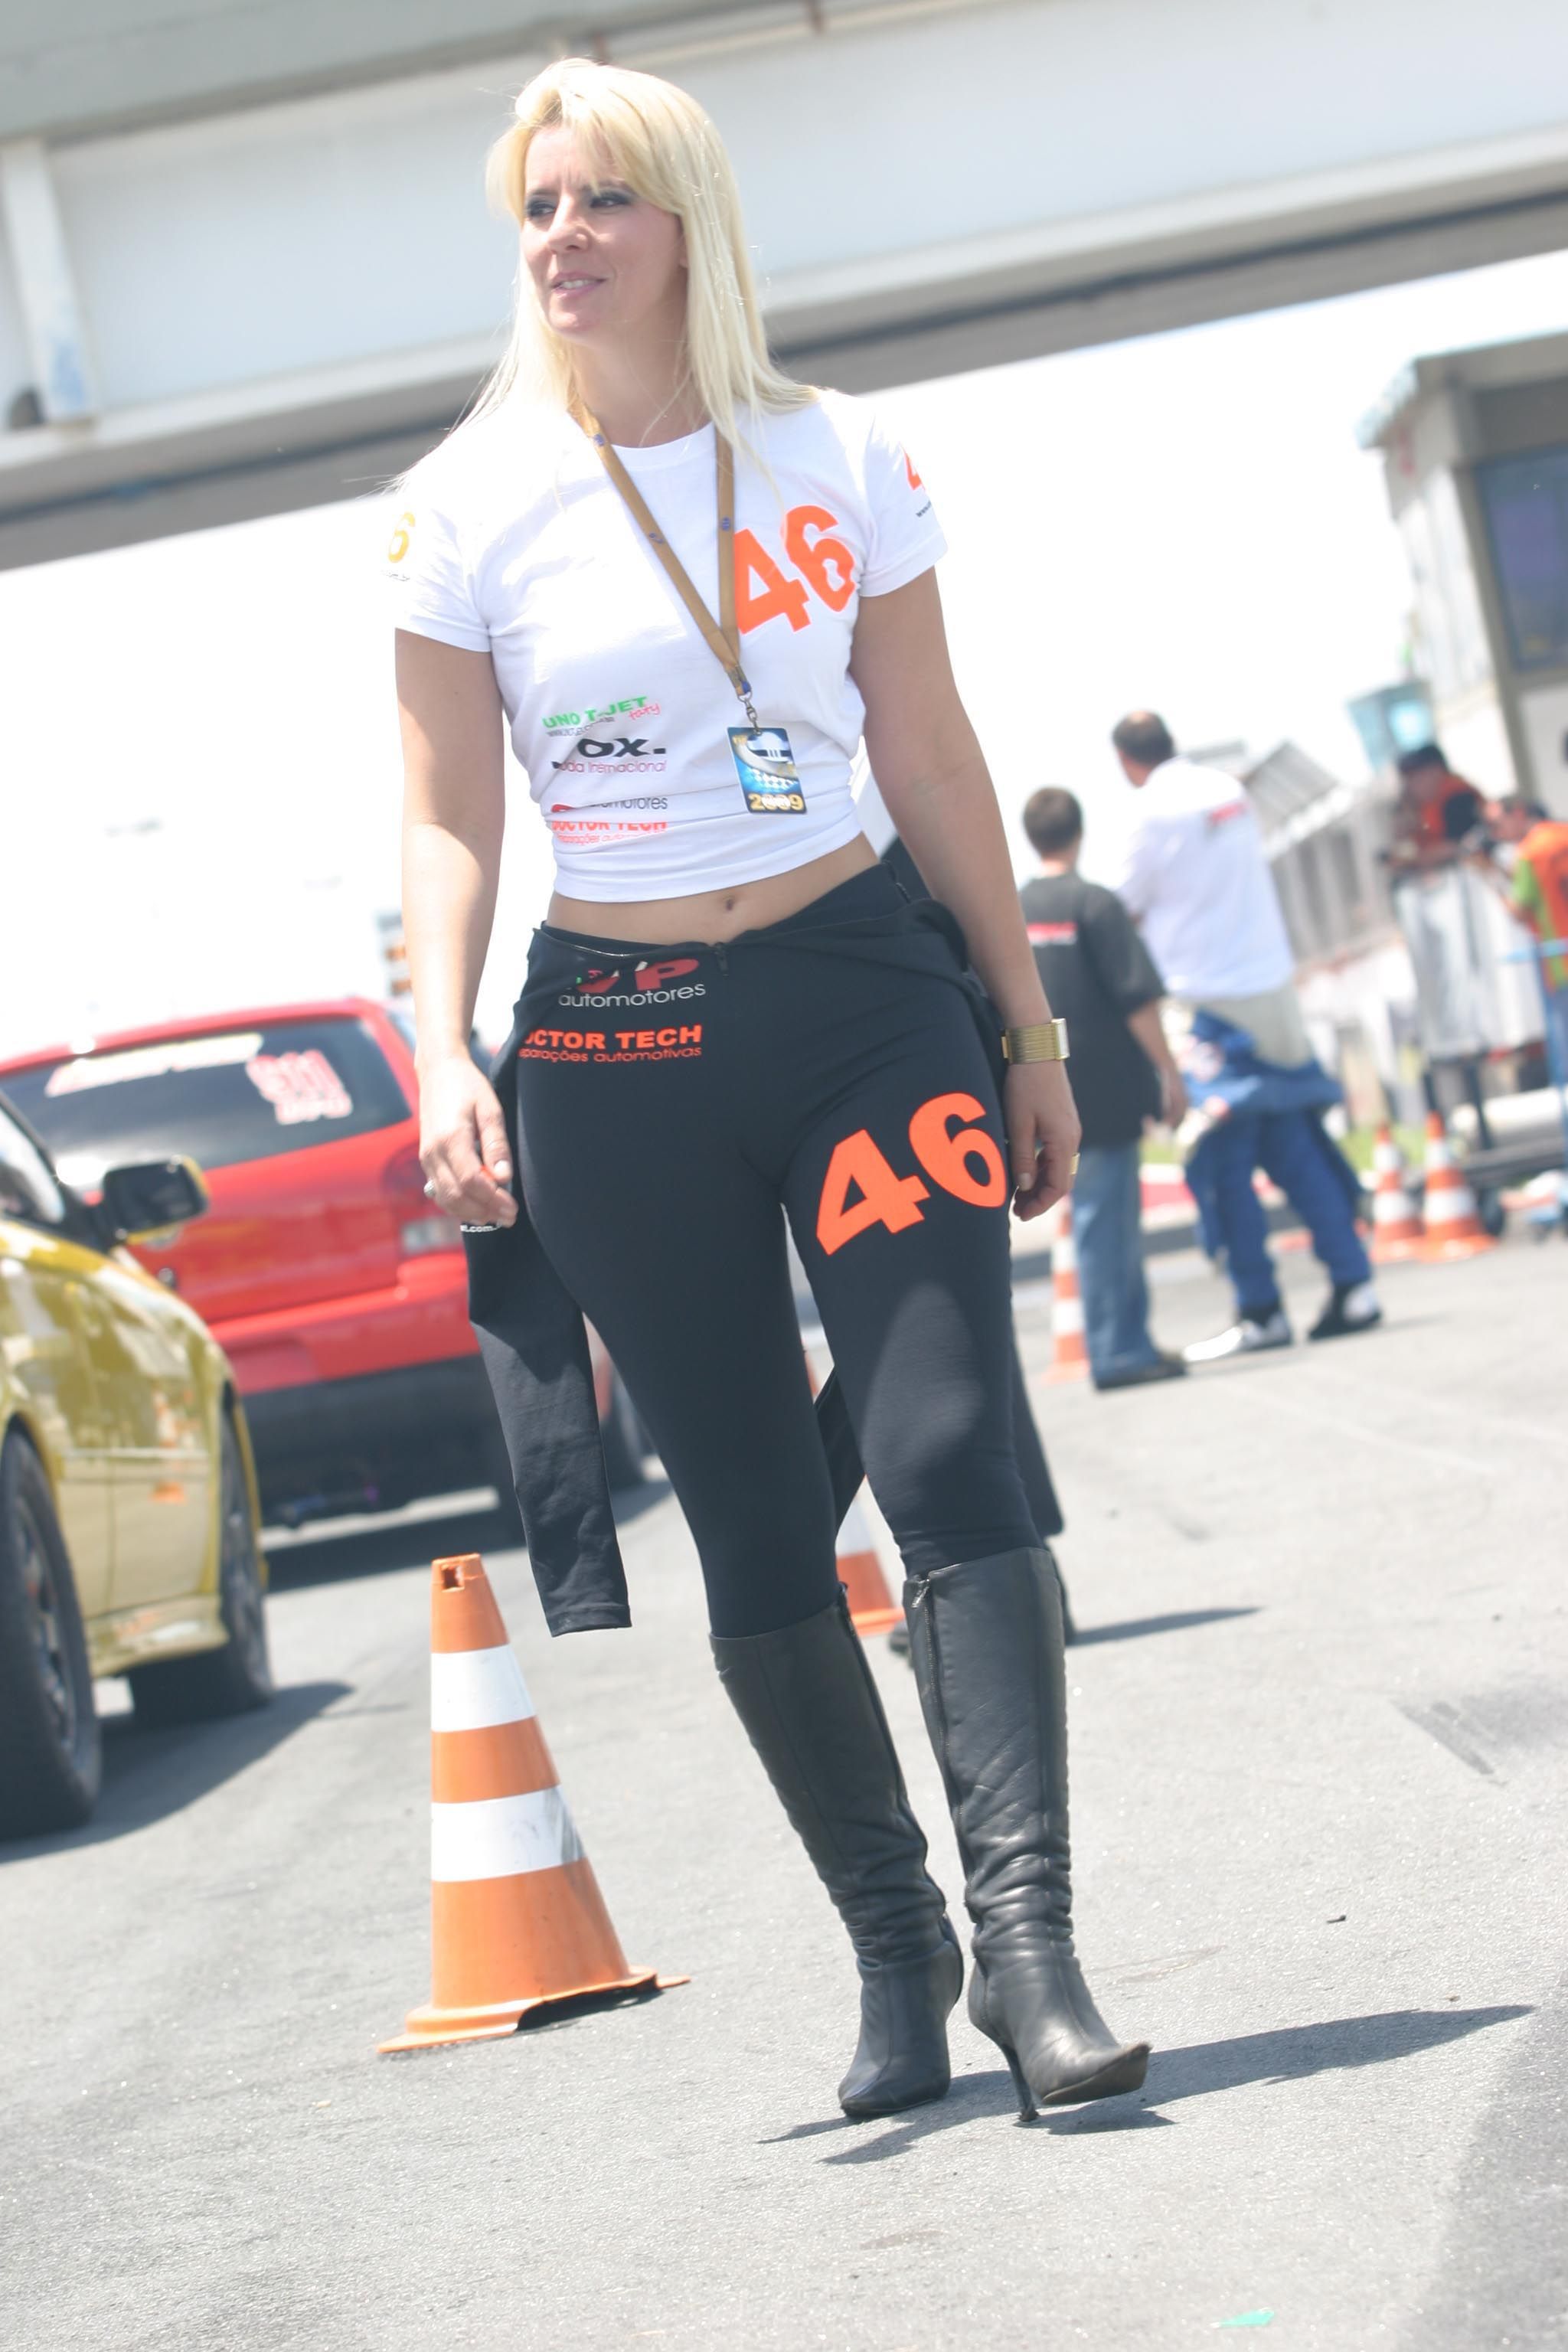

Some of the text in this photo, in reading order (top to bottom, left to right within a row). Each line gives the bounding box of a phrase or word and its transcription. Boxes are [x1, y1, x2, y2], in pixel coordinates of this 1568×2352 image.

[734, 504, 857, 635] 46
[542, 711, 580, 728] UNO
[585, 696, 647, 721] T-JET
[558, 983, 706, 1008] automotores
[614, 1024, 703, 1050] TECH
[593, 1045, 703, 1063] automotivas
[815, 1090, 1008, 1256] 46
